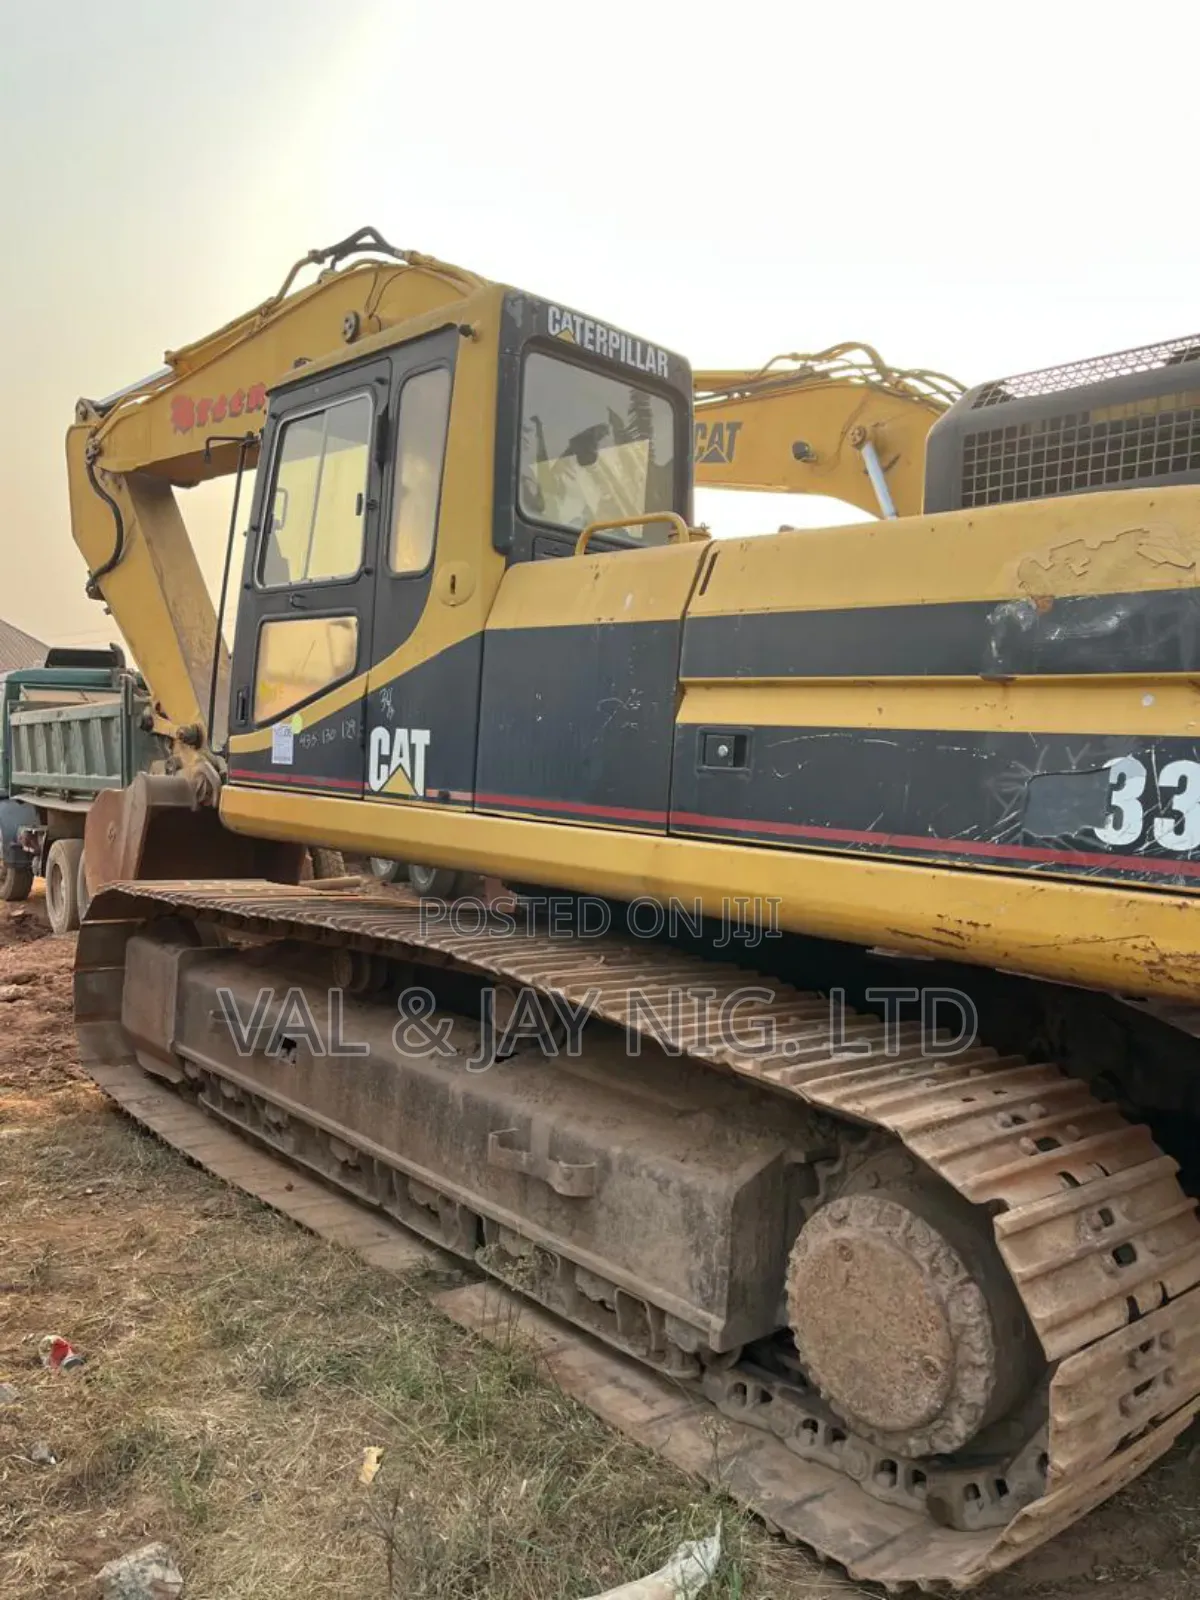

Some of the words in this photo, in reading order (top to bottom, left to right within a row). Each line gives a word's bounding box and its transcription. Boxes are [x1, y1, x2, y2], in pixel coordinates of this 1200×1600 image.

[547, 306, 669, 378] CATERPILLAR
[694, 421, 743, 463] CAT
[369, 726, 431, 796] CAT
[1094, 755, 1200, 850] 33
